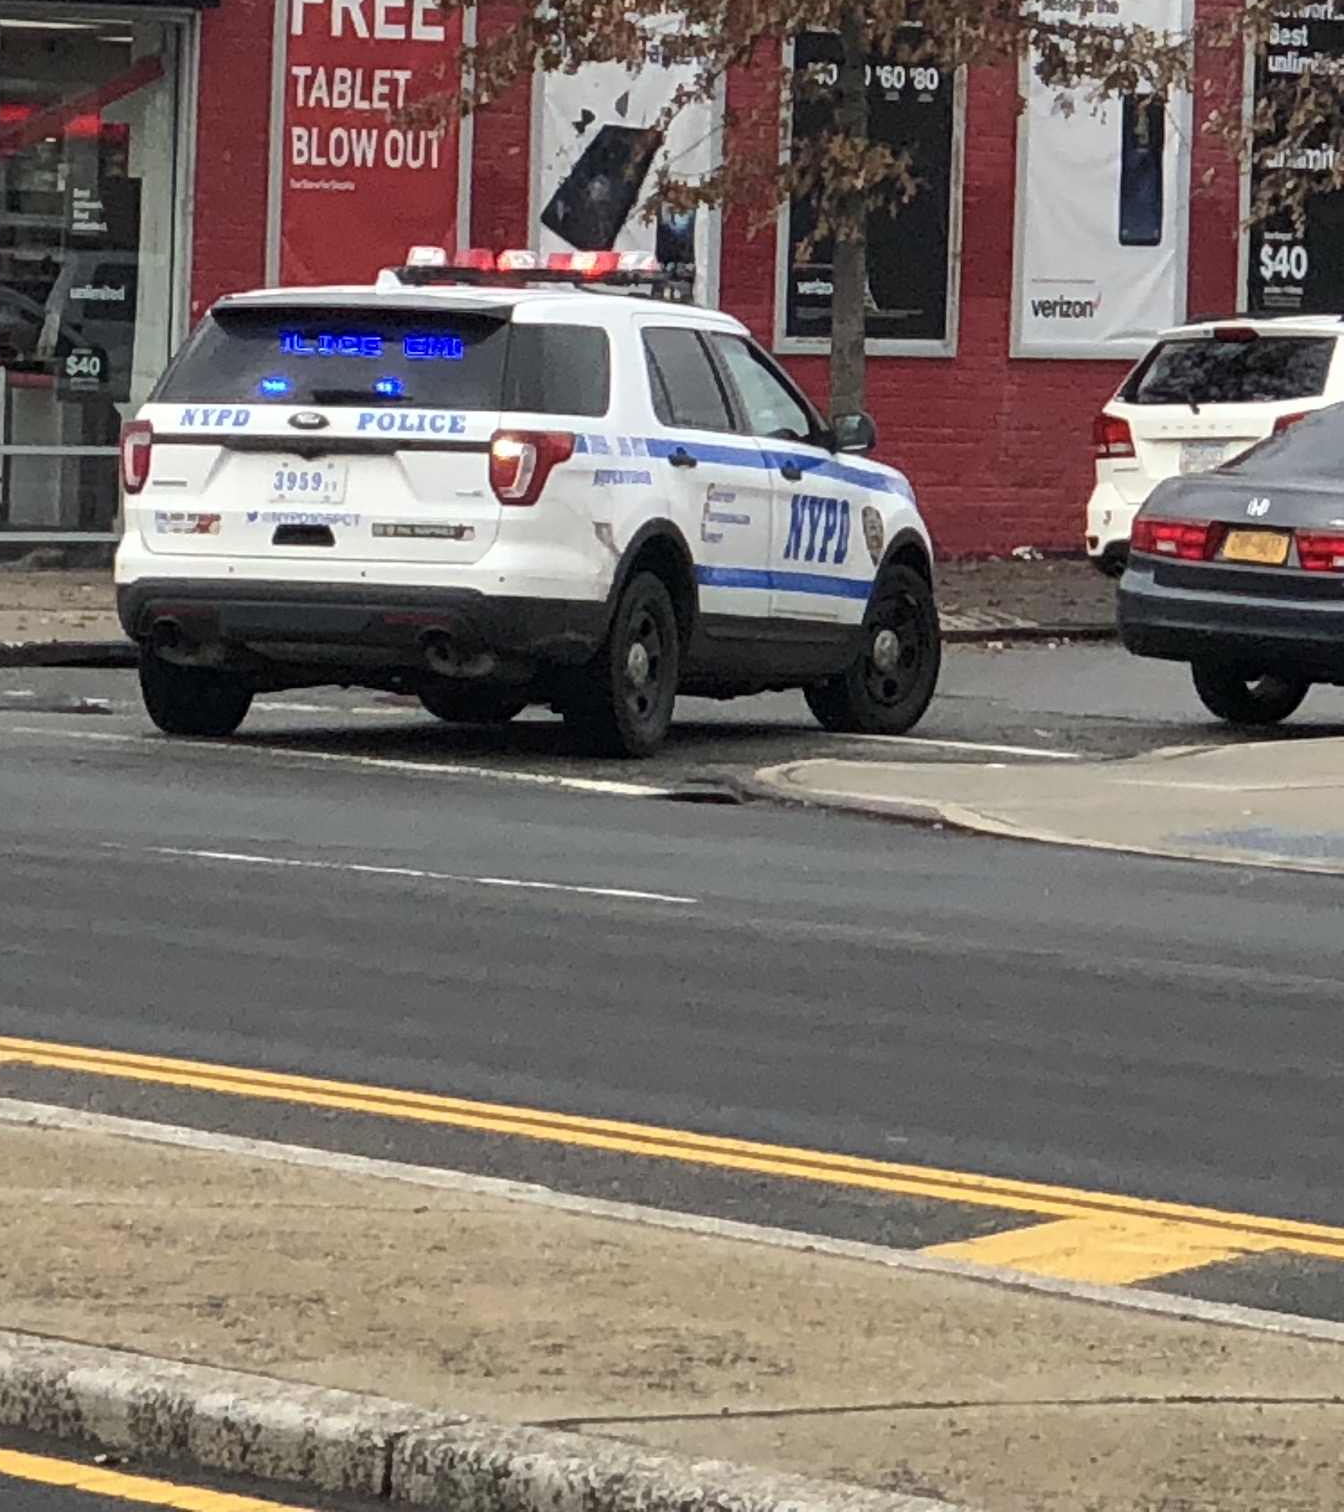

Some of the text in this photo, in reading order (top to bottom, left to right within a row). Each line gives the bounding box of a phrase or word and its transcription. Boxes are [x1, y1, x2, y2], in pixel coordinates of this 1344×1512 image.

[291, 66, 413, 109] TABLET
[290, 127, 440, 169] BLOW OUT
[1259, 244, 1309, 282] $40
[1031, 294, 1094, 319] verizon
[66, 354, 101, 376] $40
[180, 409, 467, 434] NYPD POLICE
[273, 471, 323, 492] 3959
[783, 493, 850, 564] NYPD
